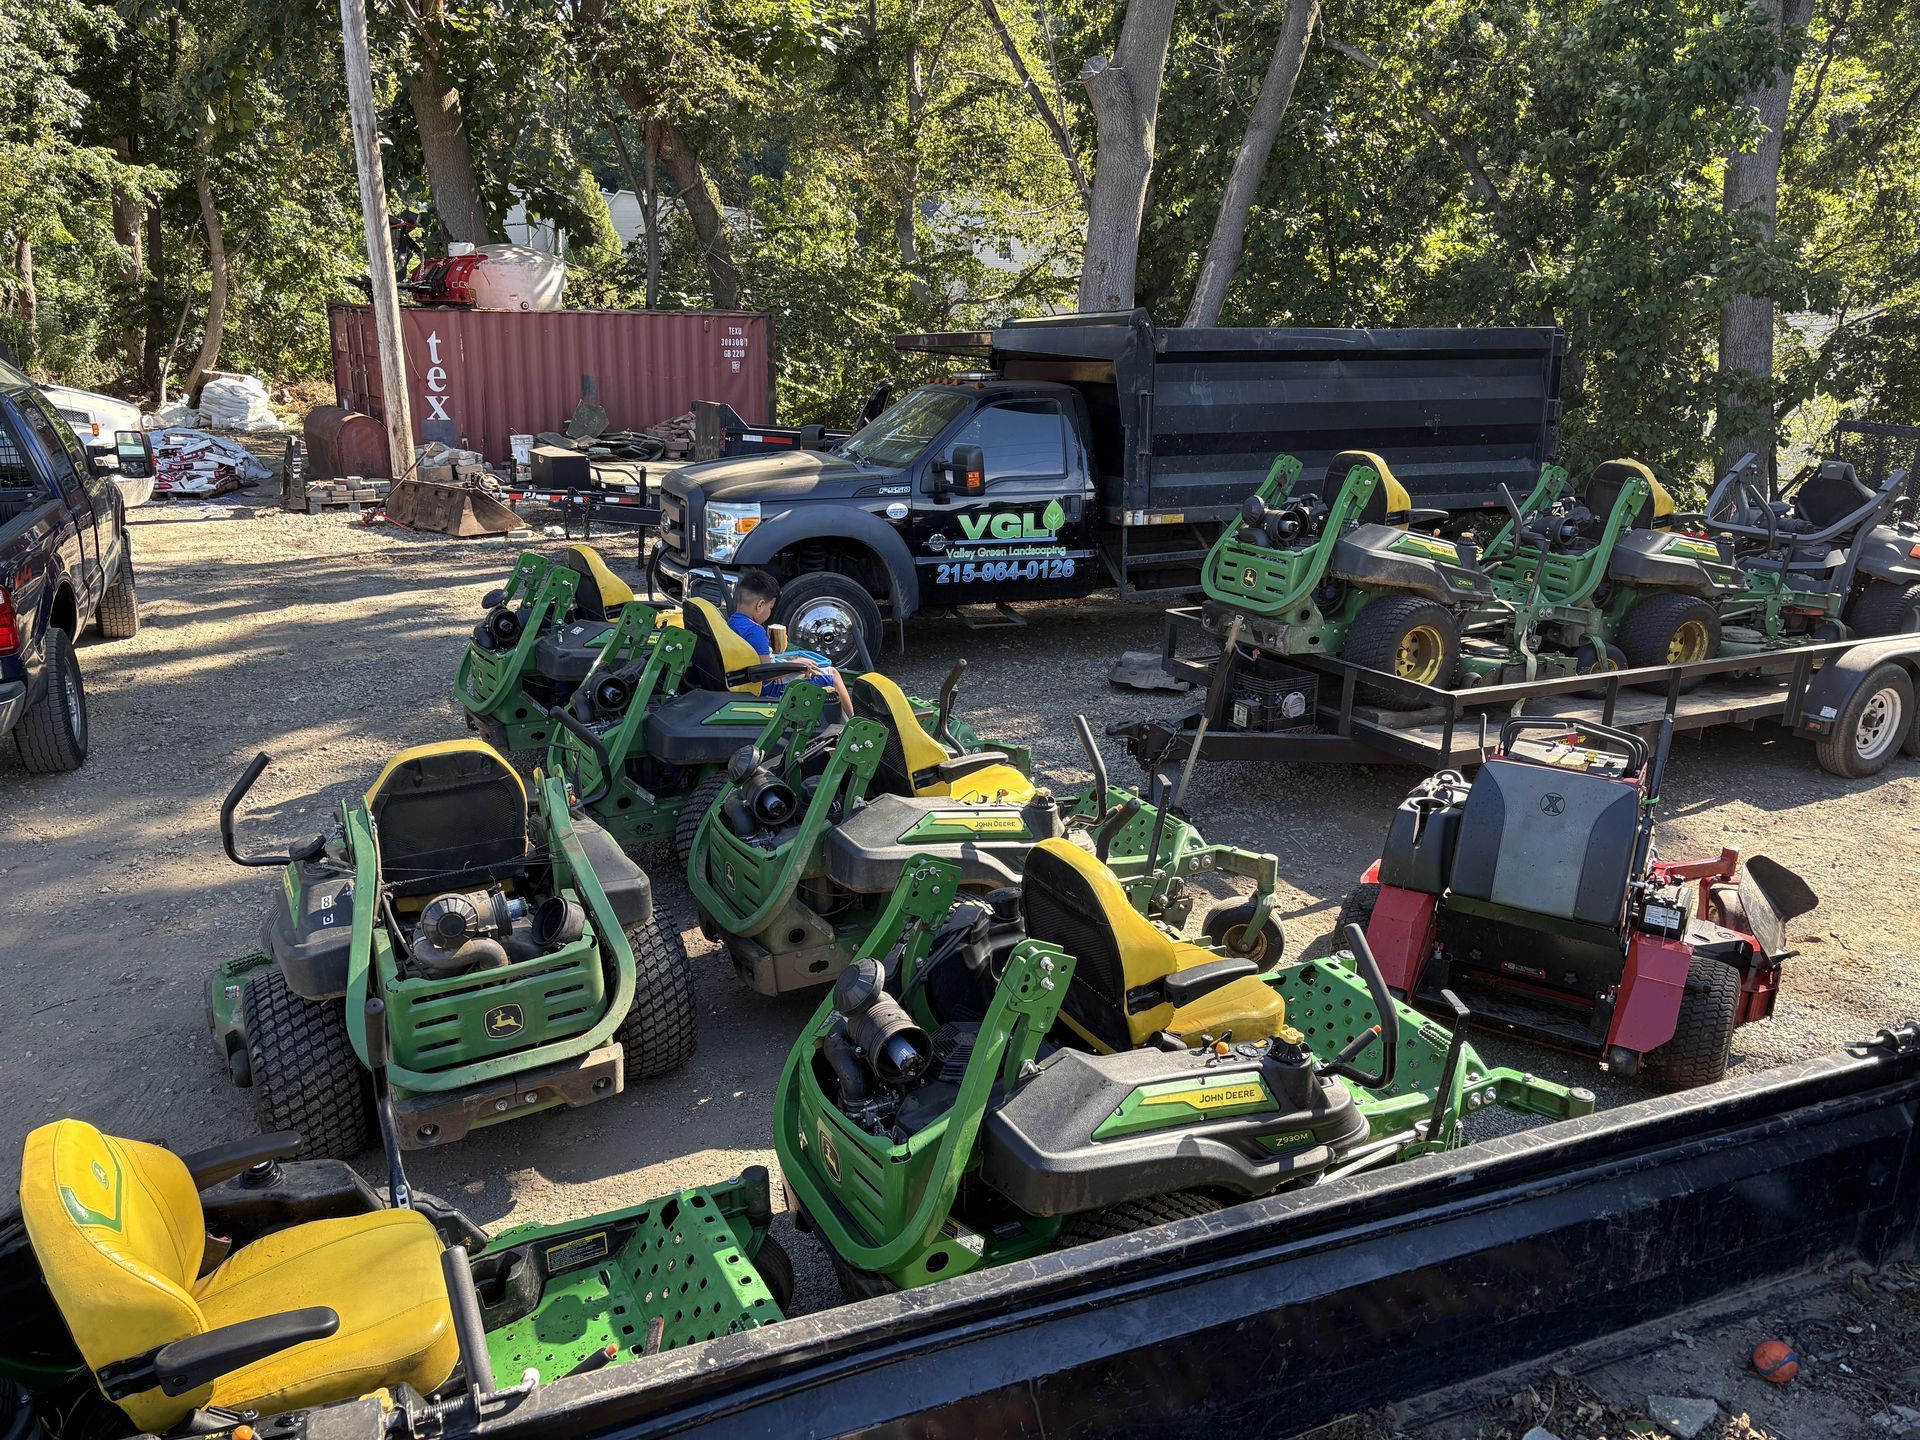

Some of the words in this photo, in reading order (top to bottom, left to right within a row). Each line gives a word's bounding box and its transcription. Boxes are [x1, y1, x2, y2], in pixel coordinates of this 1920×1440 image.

[728, 327, 742, 335] TEXU
[425, 330, 451, 421] tex
[523, 491, 537, 500] PJ
[957, 512, 1050, 540] VGL
[946, 547, 976, 560] Valley
[977, 547, 1007, 557] Green
[1008, 544, 1067, 558] Landscaping
[936, 559, 1075, 583] 215-964-0126
[993, 820, 1016, 828] DEERE
[1199, 1092, 1224, 1104] JOHN
[1225, 1089, 1256, 1100] DEERE
[1275, 1132, 1309, 1147] Z930M
